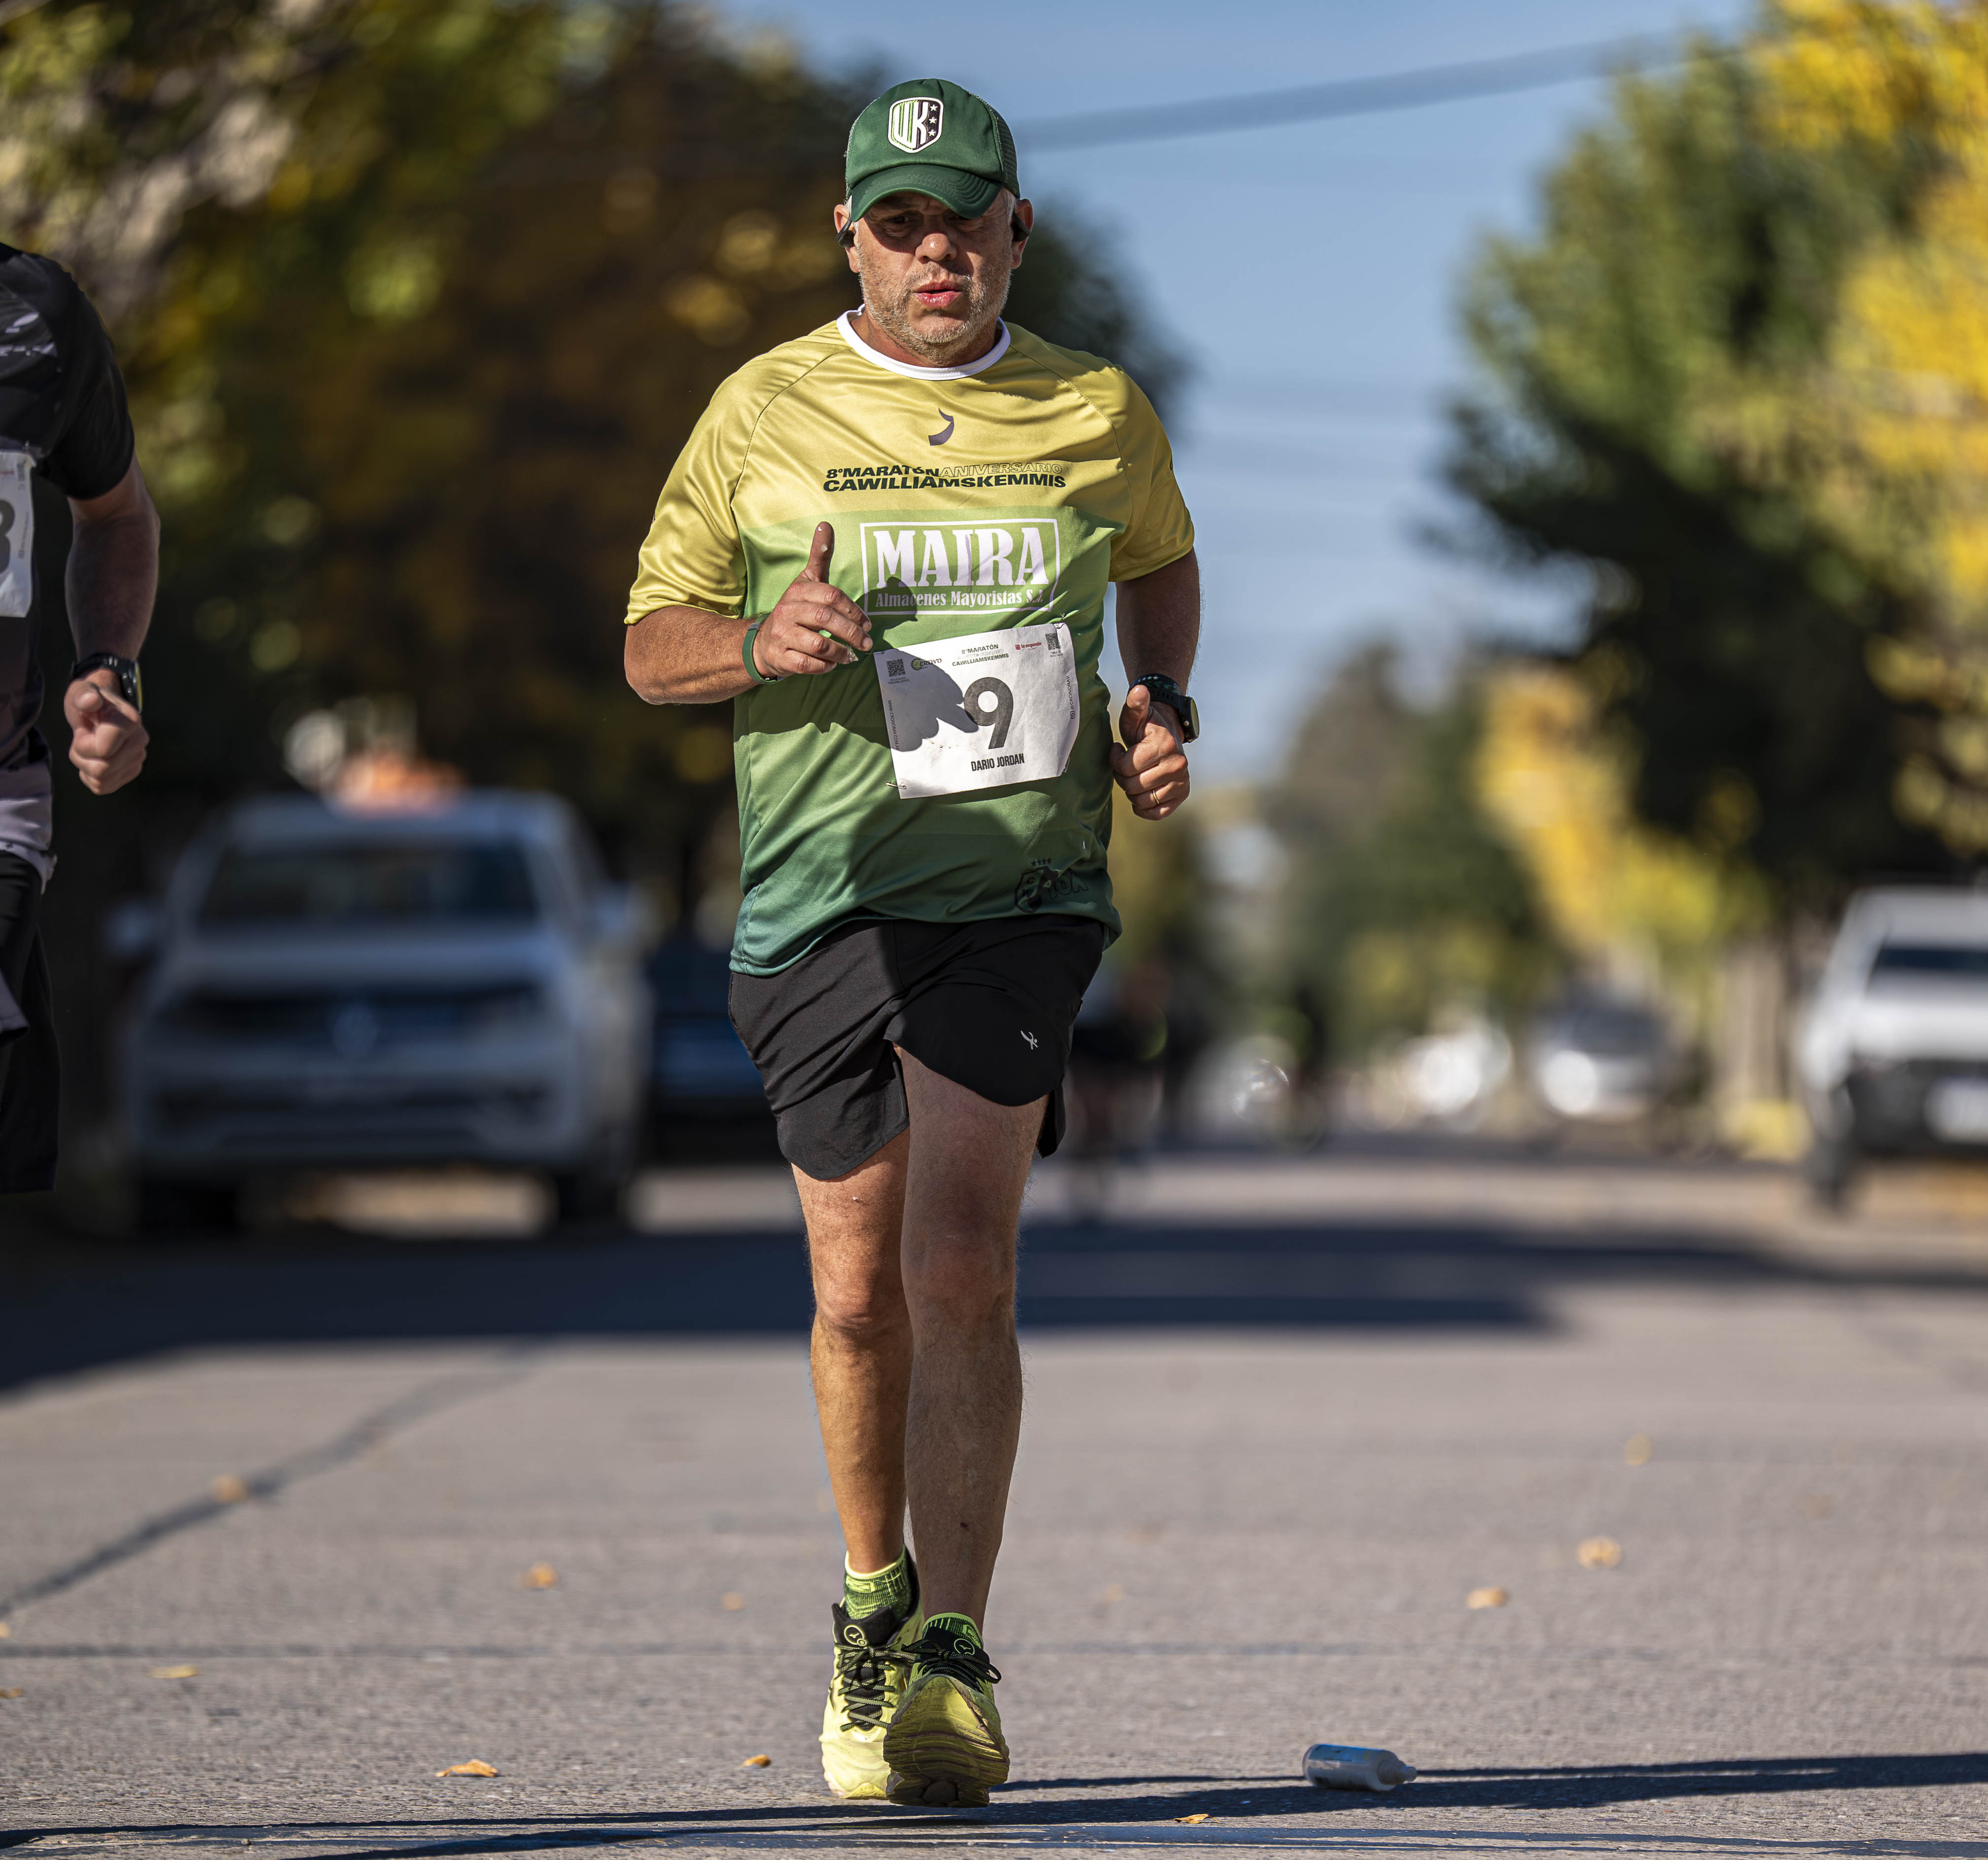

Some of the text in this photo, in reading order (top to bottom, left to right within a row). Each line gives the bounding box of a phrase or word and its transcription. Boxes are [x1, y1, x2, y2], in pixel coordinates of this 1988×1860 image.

[939, 462, 1063, 478] ANIVERSARIO
[823, 473, 1066, 492] CAWILLIAMSKEMMIS
[873, 527, 1049, 588] MAIRA
[876, 592, 947, 607] Almacenes
[950, 590, 1022, 608] Mayoristas
[952, 653, 1009, 667] CAWILLIAMSKEMMIS
[963, 677, 1014, 750] 9
[970, 753, 1025, 772] DARIO JORDAN
